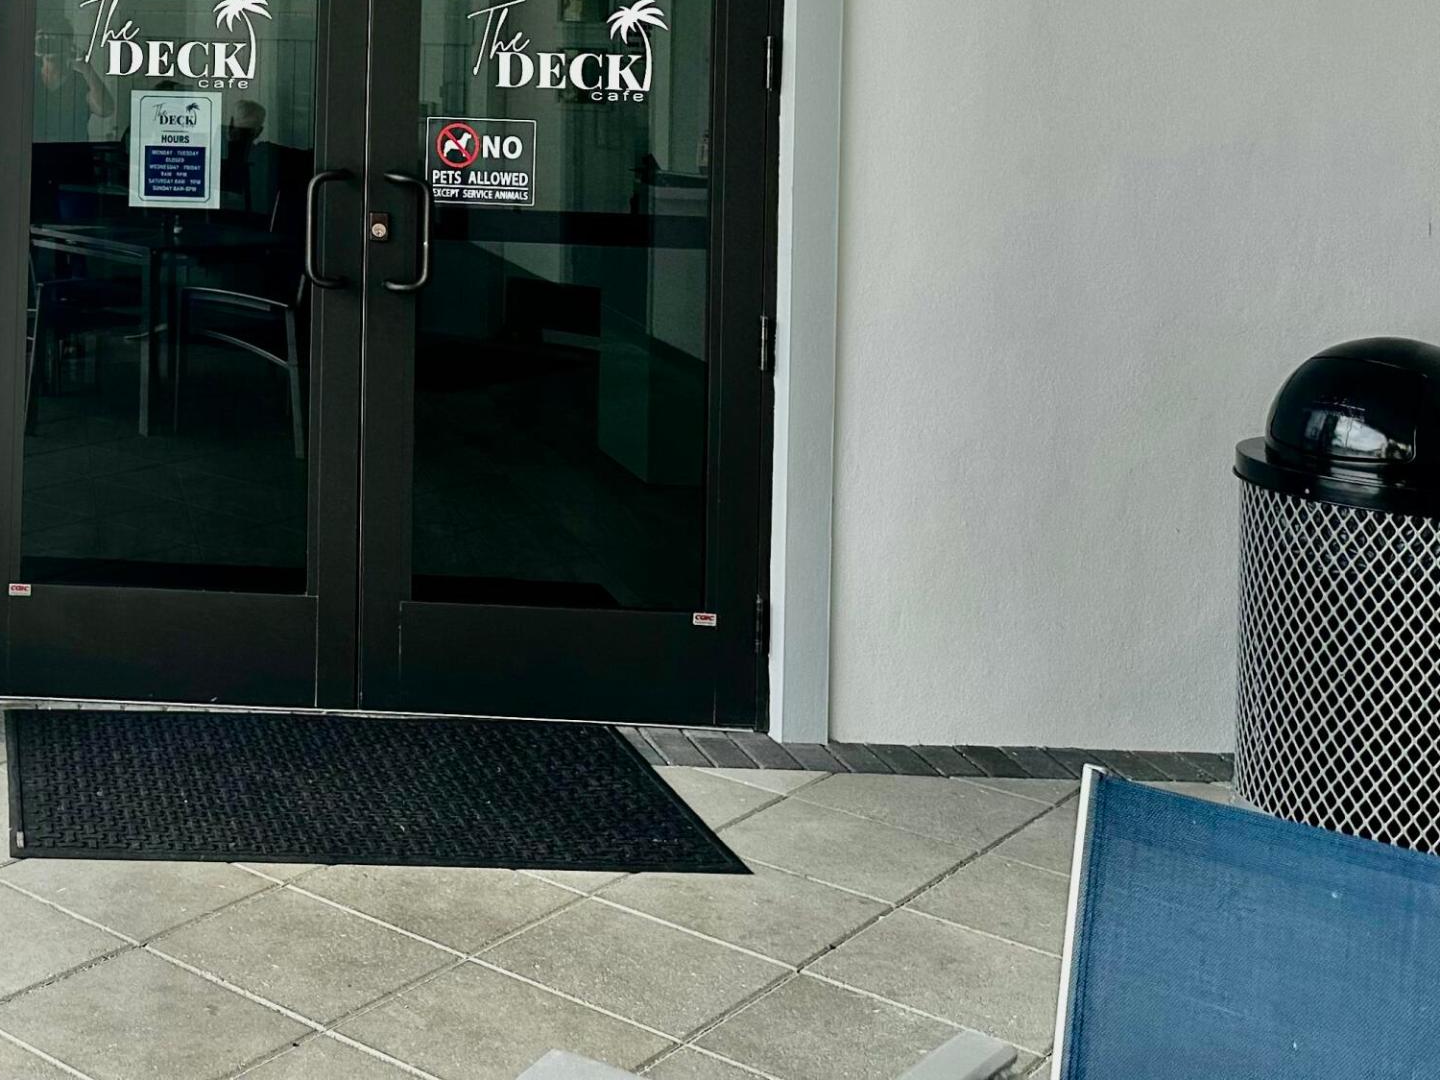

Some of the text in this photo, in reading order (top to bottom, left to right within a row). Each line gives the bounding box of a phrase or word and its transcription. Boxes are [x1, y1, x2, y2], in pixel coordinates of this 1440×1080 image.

[105, 39, 251, 79] DECK
[495, 51, 645, 91] DECK
[197, 77, 250, 89] cafe
[590, 90, 645, 102] cafe
[160, 115, 194, 125] DECK
[161, 134, 190, 144] HOURS
[481, 134, 523, 160] NO
[432, 169, 529, 186] PETS ALLOWED
[432, 188, 529, 200] EXCEPT SERVICE ANIMALS
